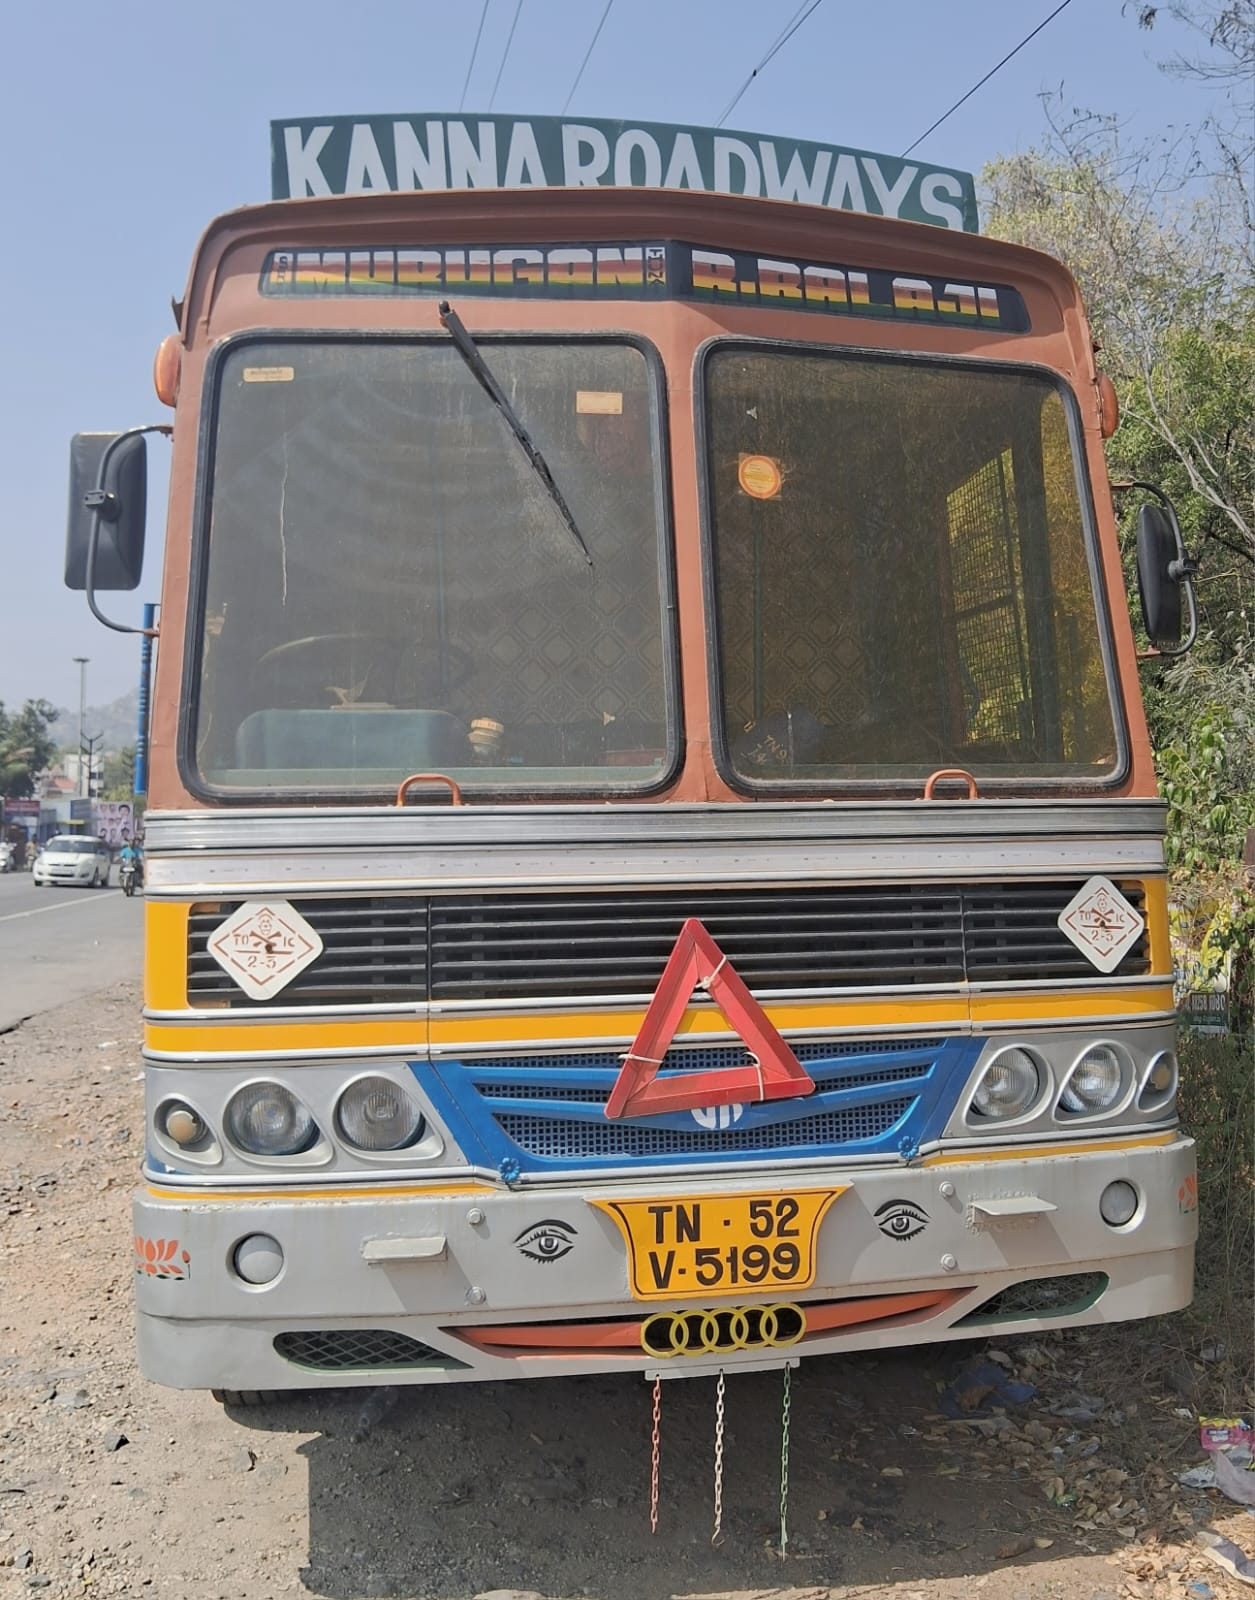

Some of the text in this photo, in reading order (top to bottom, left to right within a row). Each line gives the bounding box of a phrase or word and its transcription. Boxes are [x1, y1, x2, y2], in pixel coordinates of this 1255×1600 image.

[284, 120, 965, 232] KANNA ROADWAYS
[296, 247, 644, 297] MURUGAN
[648, 1197, 800, 1244] TN 52
